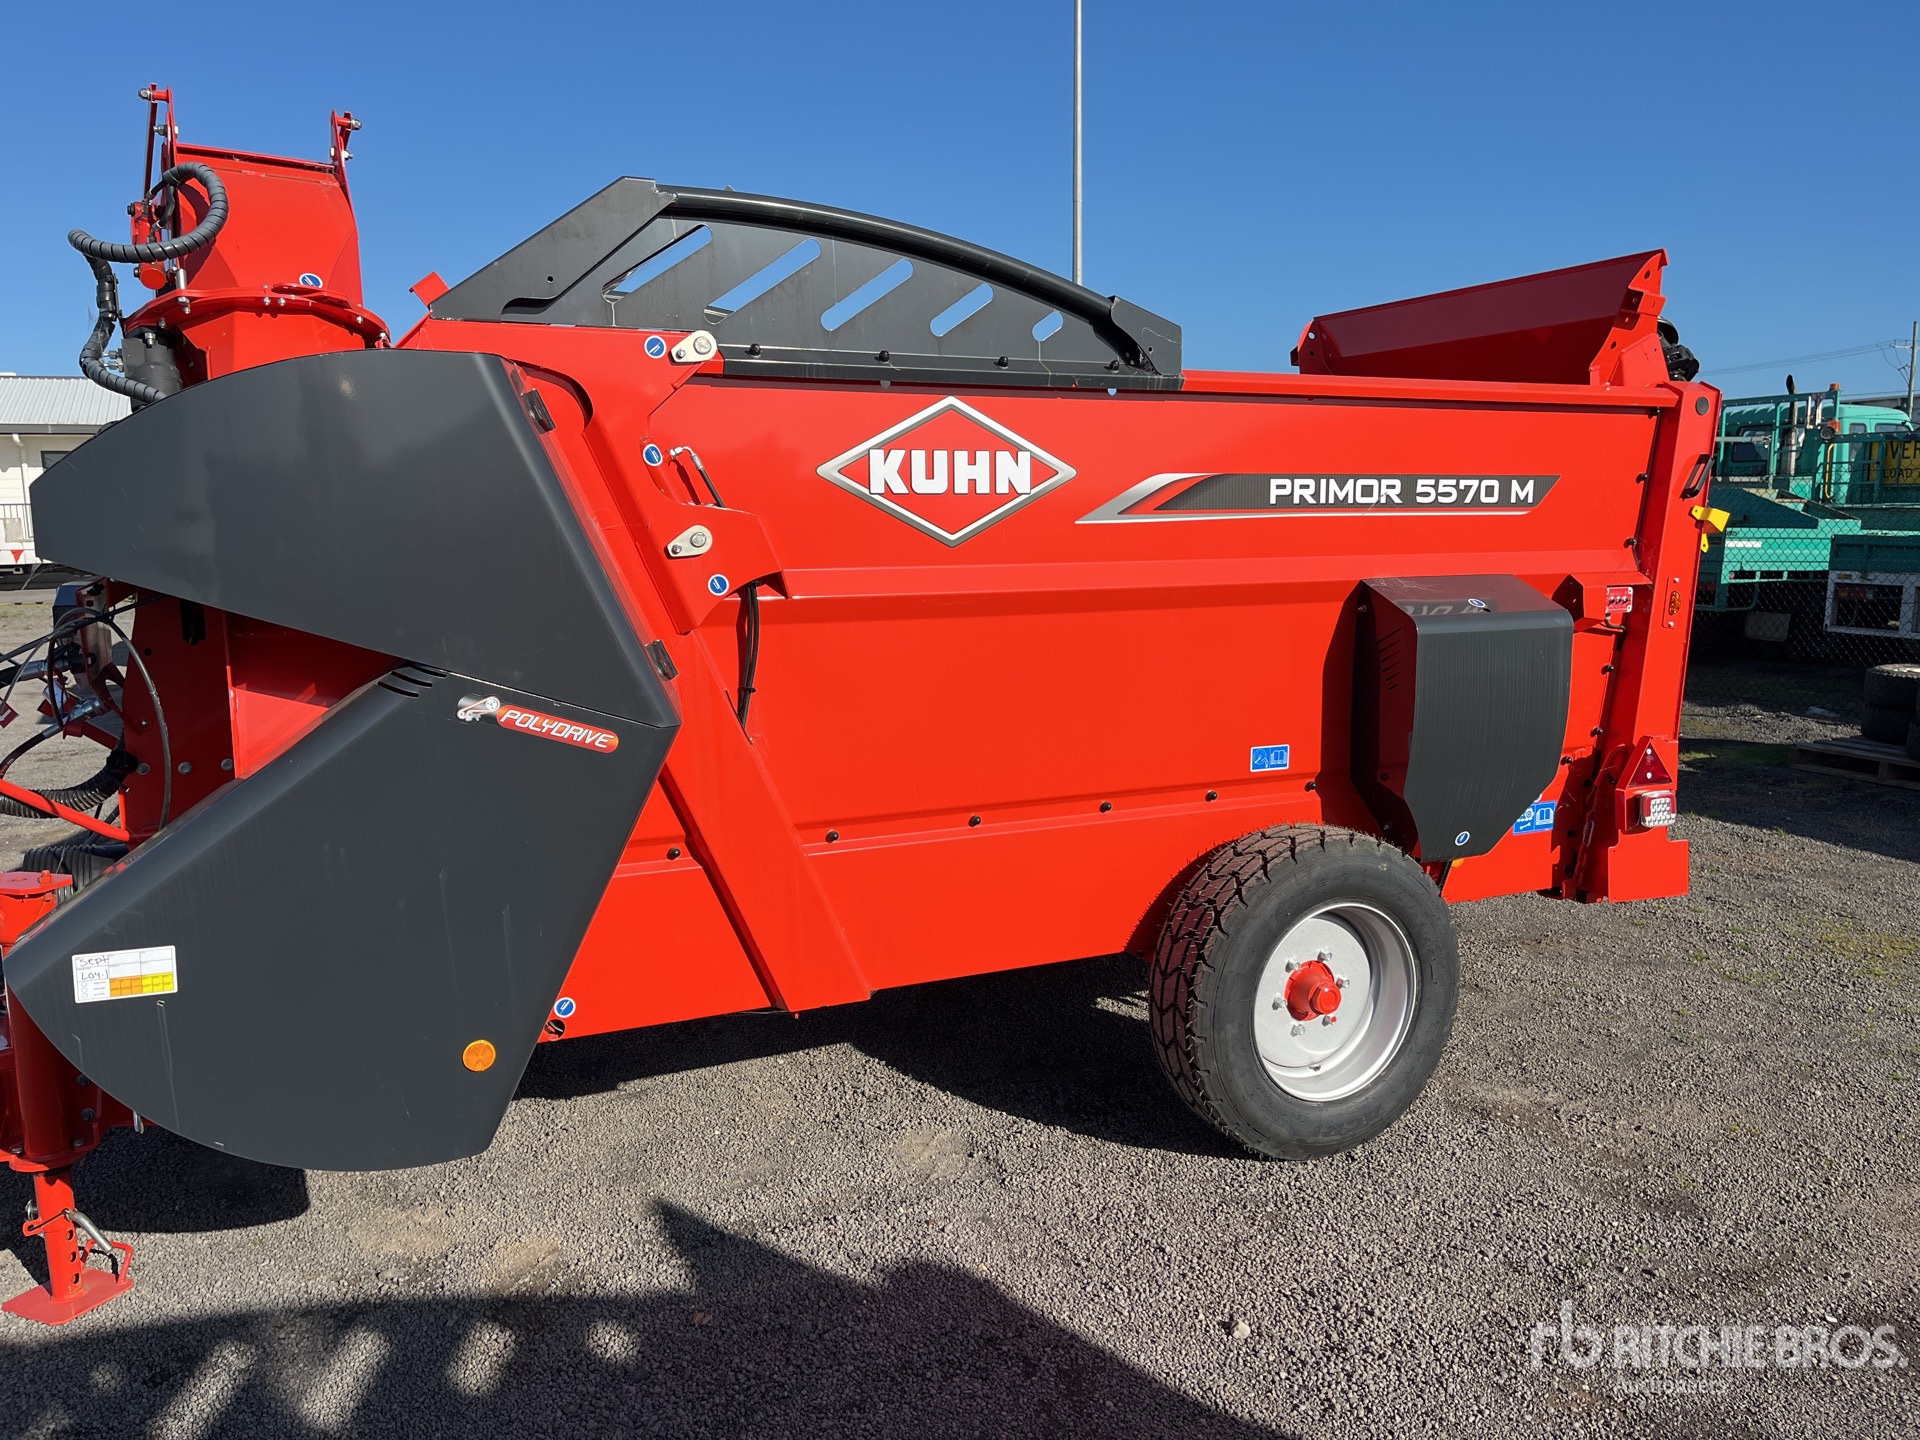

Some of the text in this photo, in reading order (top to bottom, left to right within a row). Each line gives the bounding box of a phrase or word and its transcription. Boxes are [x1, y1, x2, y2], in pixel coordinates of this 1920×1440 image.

[869, 449, 1032, 495] KUHN
[1269, 478, 1535, 505] PRIMOR 5570 M
[499, 709, 615, 749] POLYDRIVE
